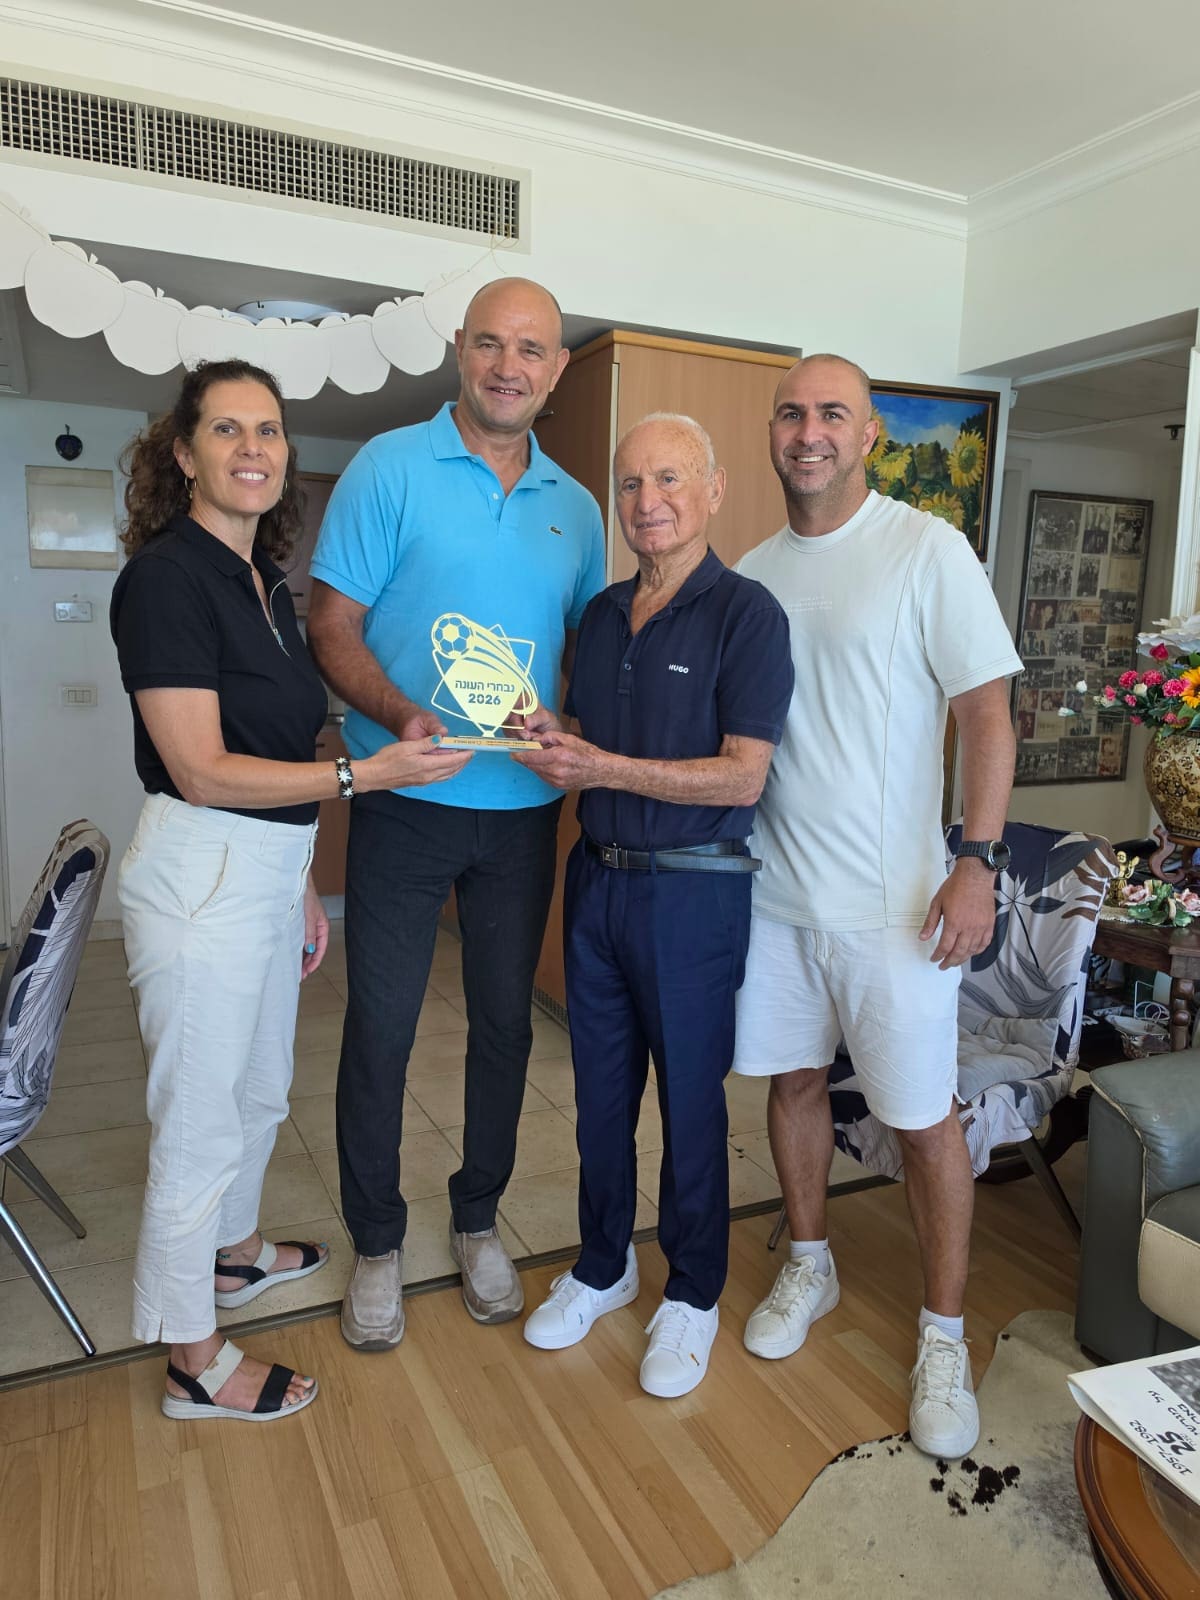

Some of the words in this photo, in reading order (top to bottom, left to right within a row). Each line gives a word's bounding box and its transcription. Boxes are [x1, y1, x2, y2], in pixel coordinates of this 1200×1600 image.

[668, 664, 689, 674] HUGO
[455, 680, 485, 691] העונה
[487, 682, 515, 693] נבחרי
[468, 693, 502, 705] 2026
[1148, 1390, 1165, 1403] על
[1167, 1407, 1198, 1436] מגרשי
[1177, 1403, 1200, 1425] באר
[1156, 1431, 1197, 1456] 25
